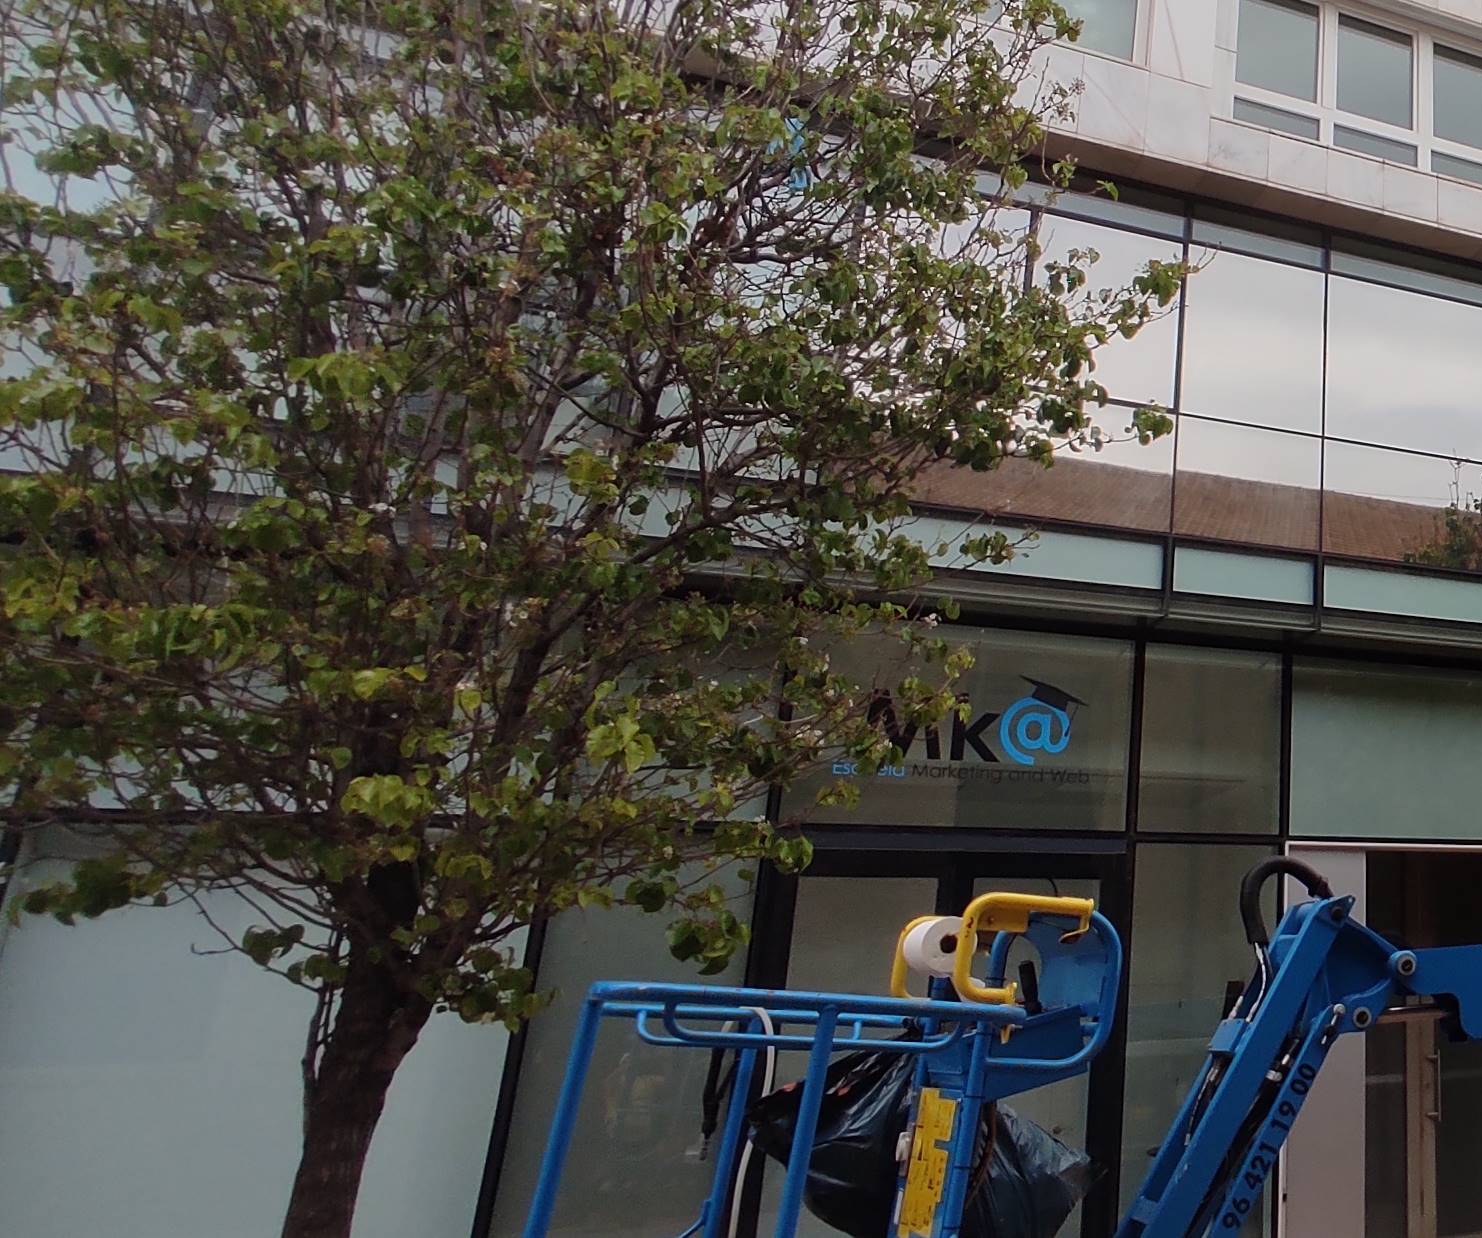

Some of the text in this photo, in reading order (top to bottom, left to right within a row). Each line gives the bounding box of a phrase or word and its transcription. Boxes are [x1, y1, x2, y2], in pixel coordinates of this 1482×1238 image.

[911, 764, 1001, 784] Marketing
[1008, 769, 1044, 782] and
[1049, 769, 1090, 785] Web
[1221, 1062, 1317, 1230] 96 421 19 00
